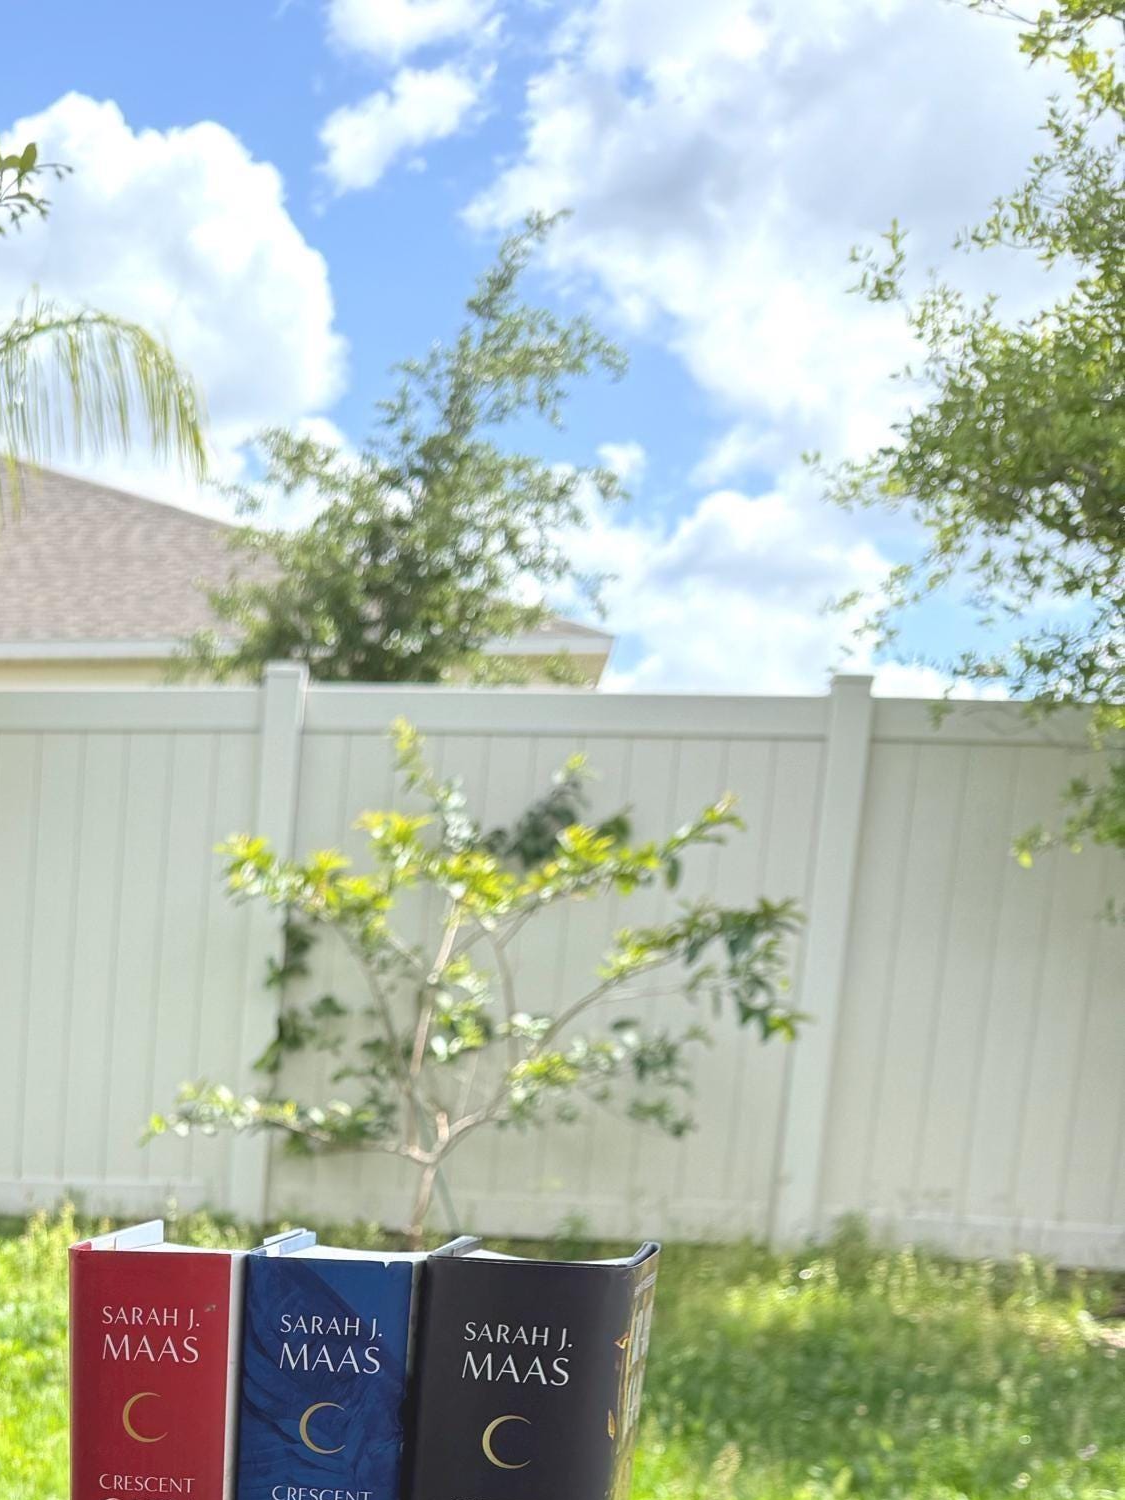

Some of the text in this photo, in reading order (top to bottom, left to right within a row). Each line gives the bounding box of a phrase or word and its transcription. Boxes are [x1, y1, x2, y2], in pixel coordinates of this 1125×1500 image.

[101, 1305, 201, 1331] SARAH J.
[280, 1314, 383, 1342] SARAH J.
[101, 1333, 200, 1364] MAAS
[464, 1321, 573, 1353] SARAH J.
[278, 1341, 381, 1375] MAAS
[461, 1350, 570, 1387] MAAS
[98, 1472, 195, 1494] CRESCENT
